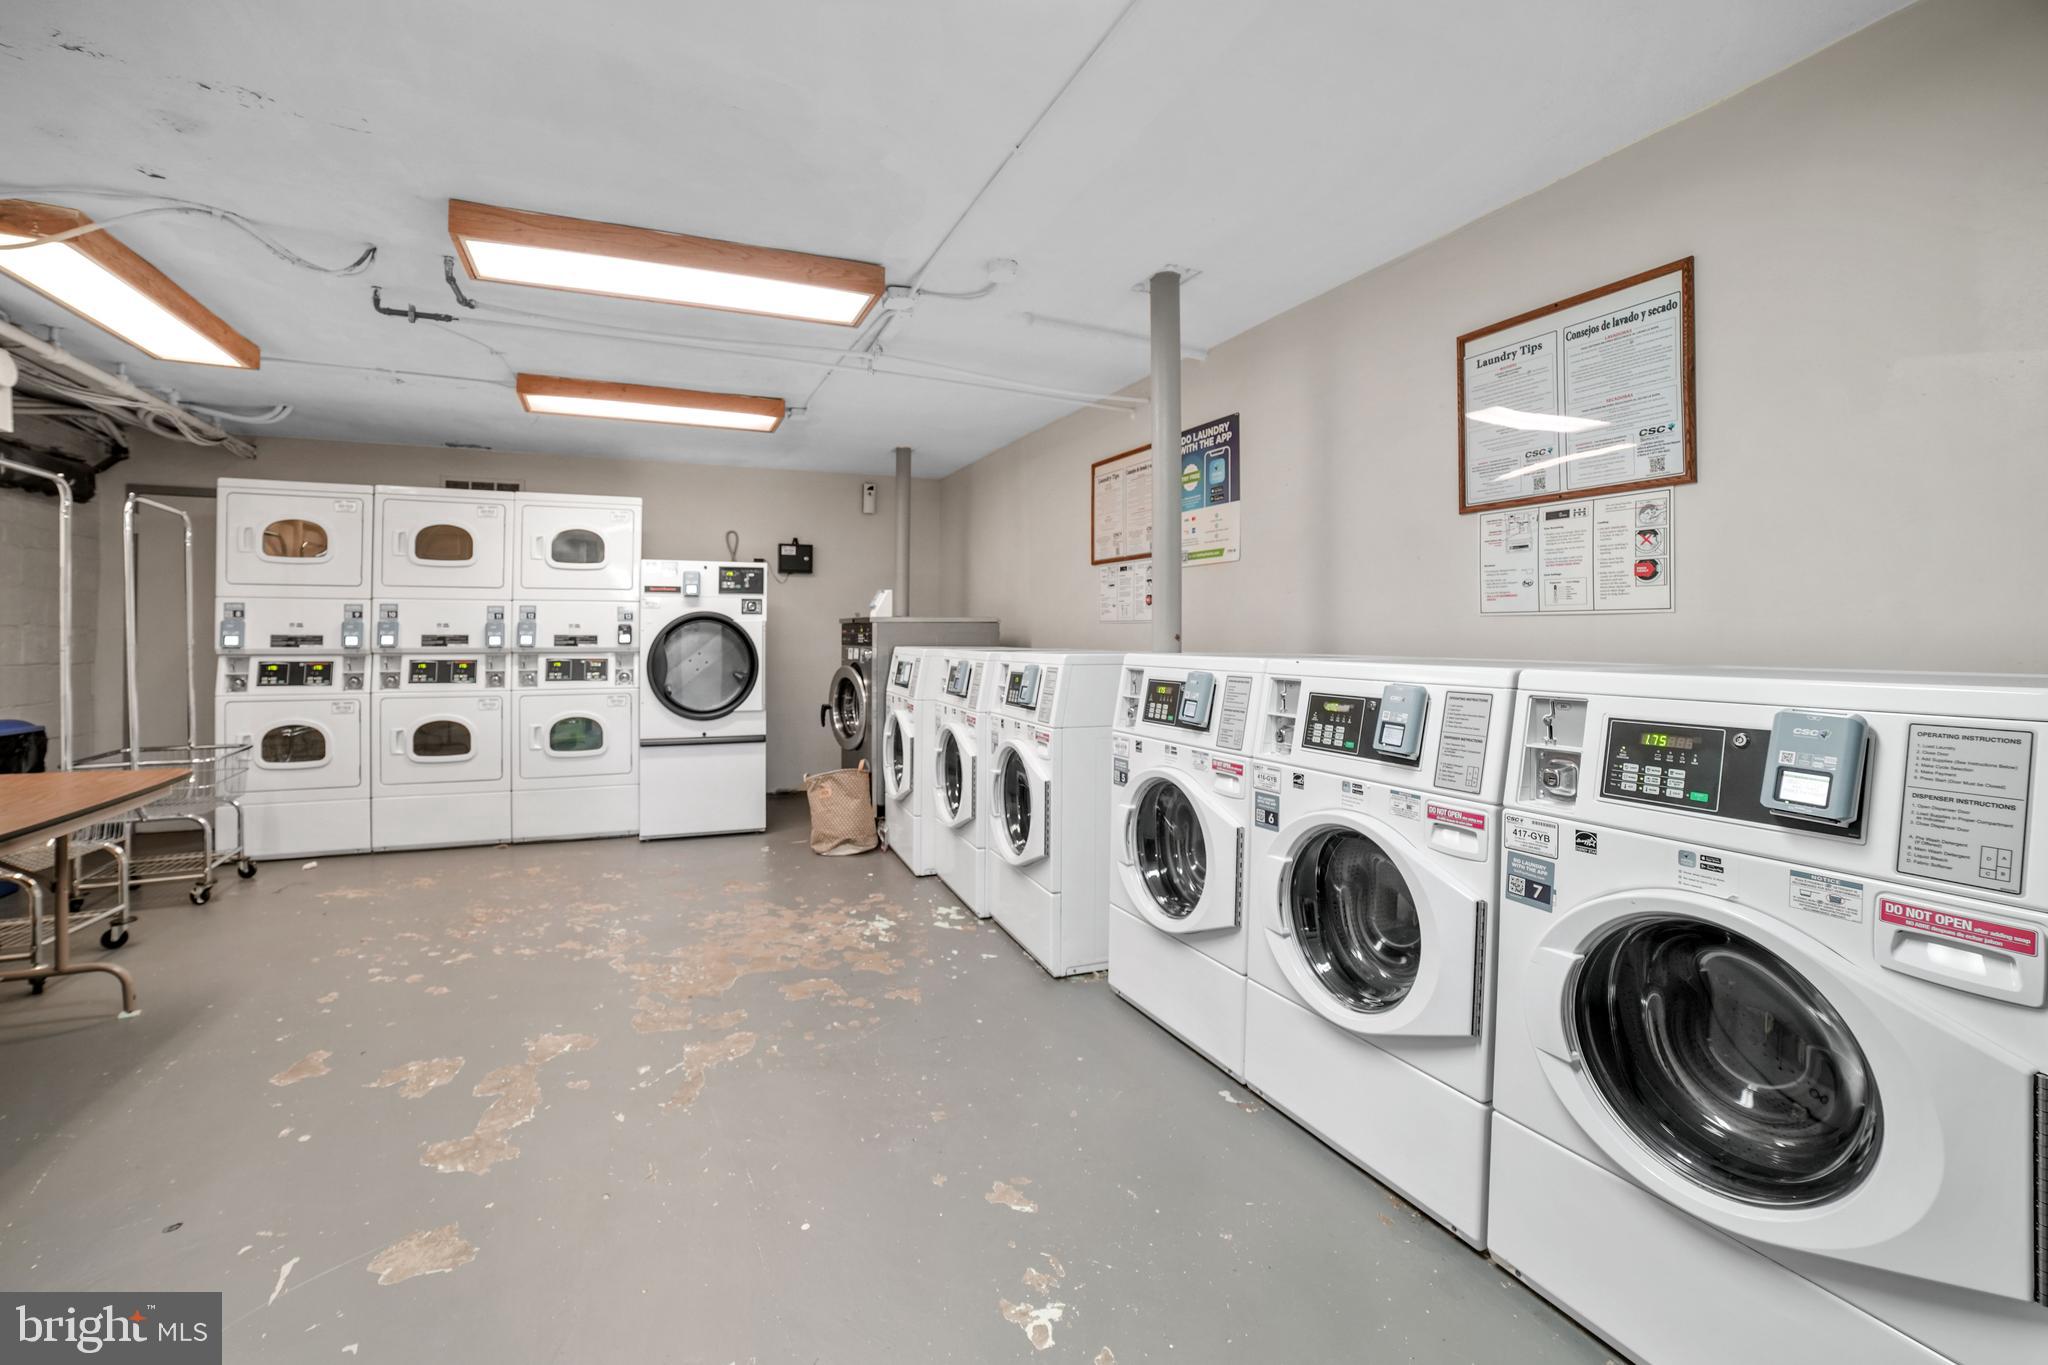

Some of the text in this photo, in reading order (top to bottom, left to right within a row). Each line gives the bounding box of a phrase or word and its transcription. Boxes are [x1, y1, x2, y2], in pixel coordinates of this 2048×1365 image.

[1565, 299, 1679, 342] Consejos de lavado y secado
[1476, 342, 1544, 370] Laundry Tips
[1181, 421, 1231, 447] DO LAUNDRY
[1639, 425, 1667, 437] CSC
[1200, 437, 1216, 450] THE
[1216, 431, 1233, 446] APP
[1525, 448, 1547, 460] CSC
[1793, 727, 1819, 737] CSC
[1916, 731, 2022, 745] OPERATING INSTRUCTIONS
[1912, 792, 2017, 811] DISPENSER INSTRUCTIONS
[1268, 812, 1276, 825] 6
[1506, 815, 1520, 823] CSC
[1512, 828, 1551, 844] 417-GYB
[1810, 873, 1842, 886] NOTICE
[1533, 884, 1544, 899] 7
[1885, 902, 1904, 916] DO
[1904, 906, 1933, 922] NOT
[1934, 914, 1973, 932] OPEN
